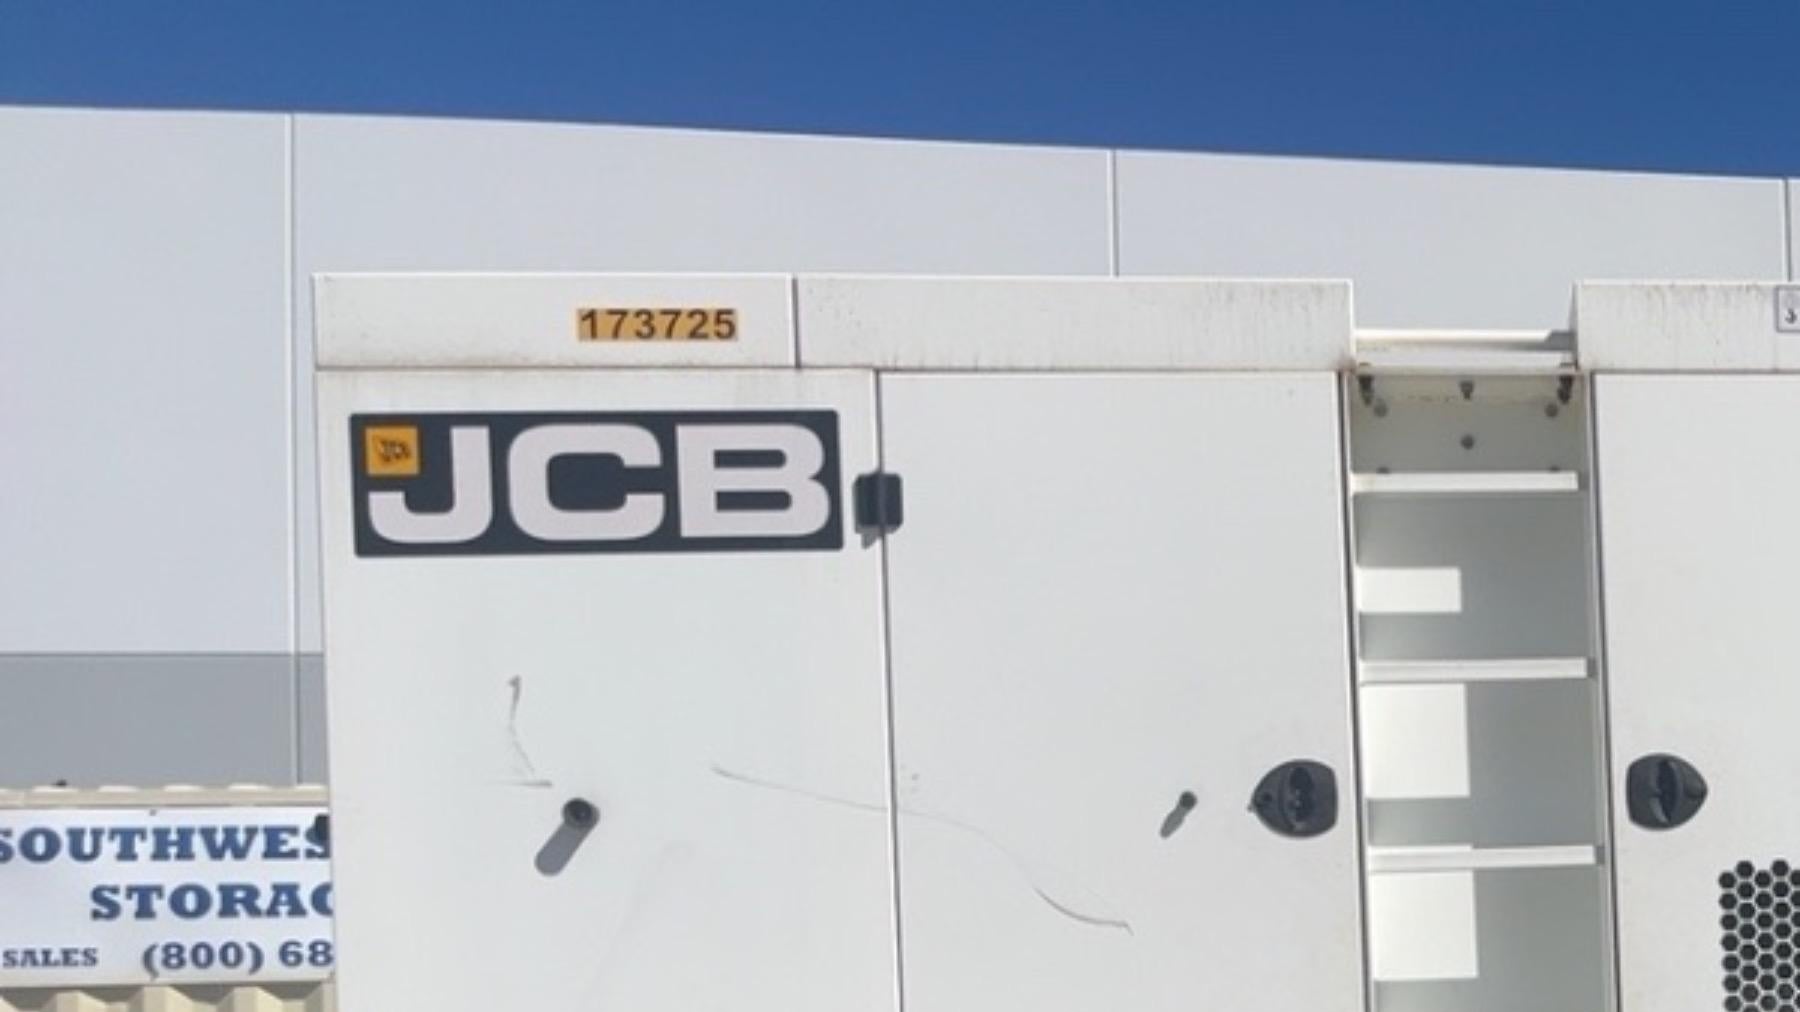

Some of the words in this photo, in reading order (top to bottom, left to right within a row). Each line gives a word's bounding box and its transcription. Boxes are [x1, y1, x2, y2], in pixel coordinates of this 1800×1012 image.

[580, 308, 736, 340] 173725
[368, 423, 830, 543] JCB
[2, 948, 98, 967] SALES
[142, 942, 264, 978] (800)
[278, 940, 333, 967] 68
